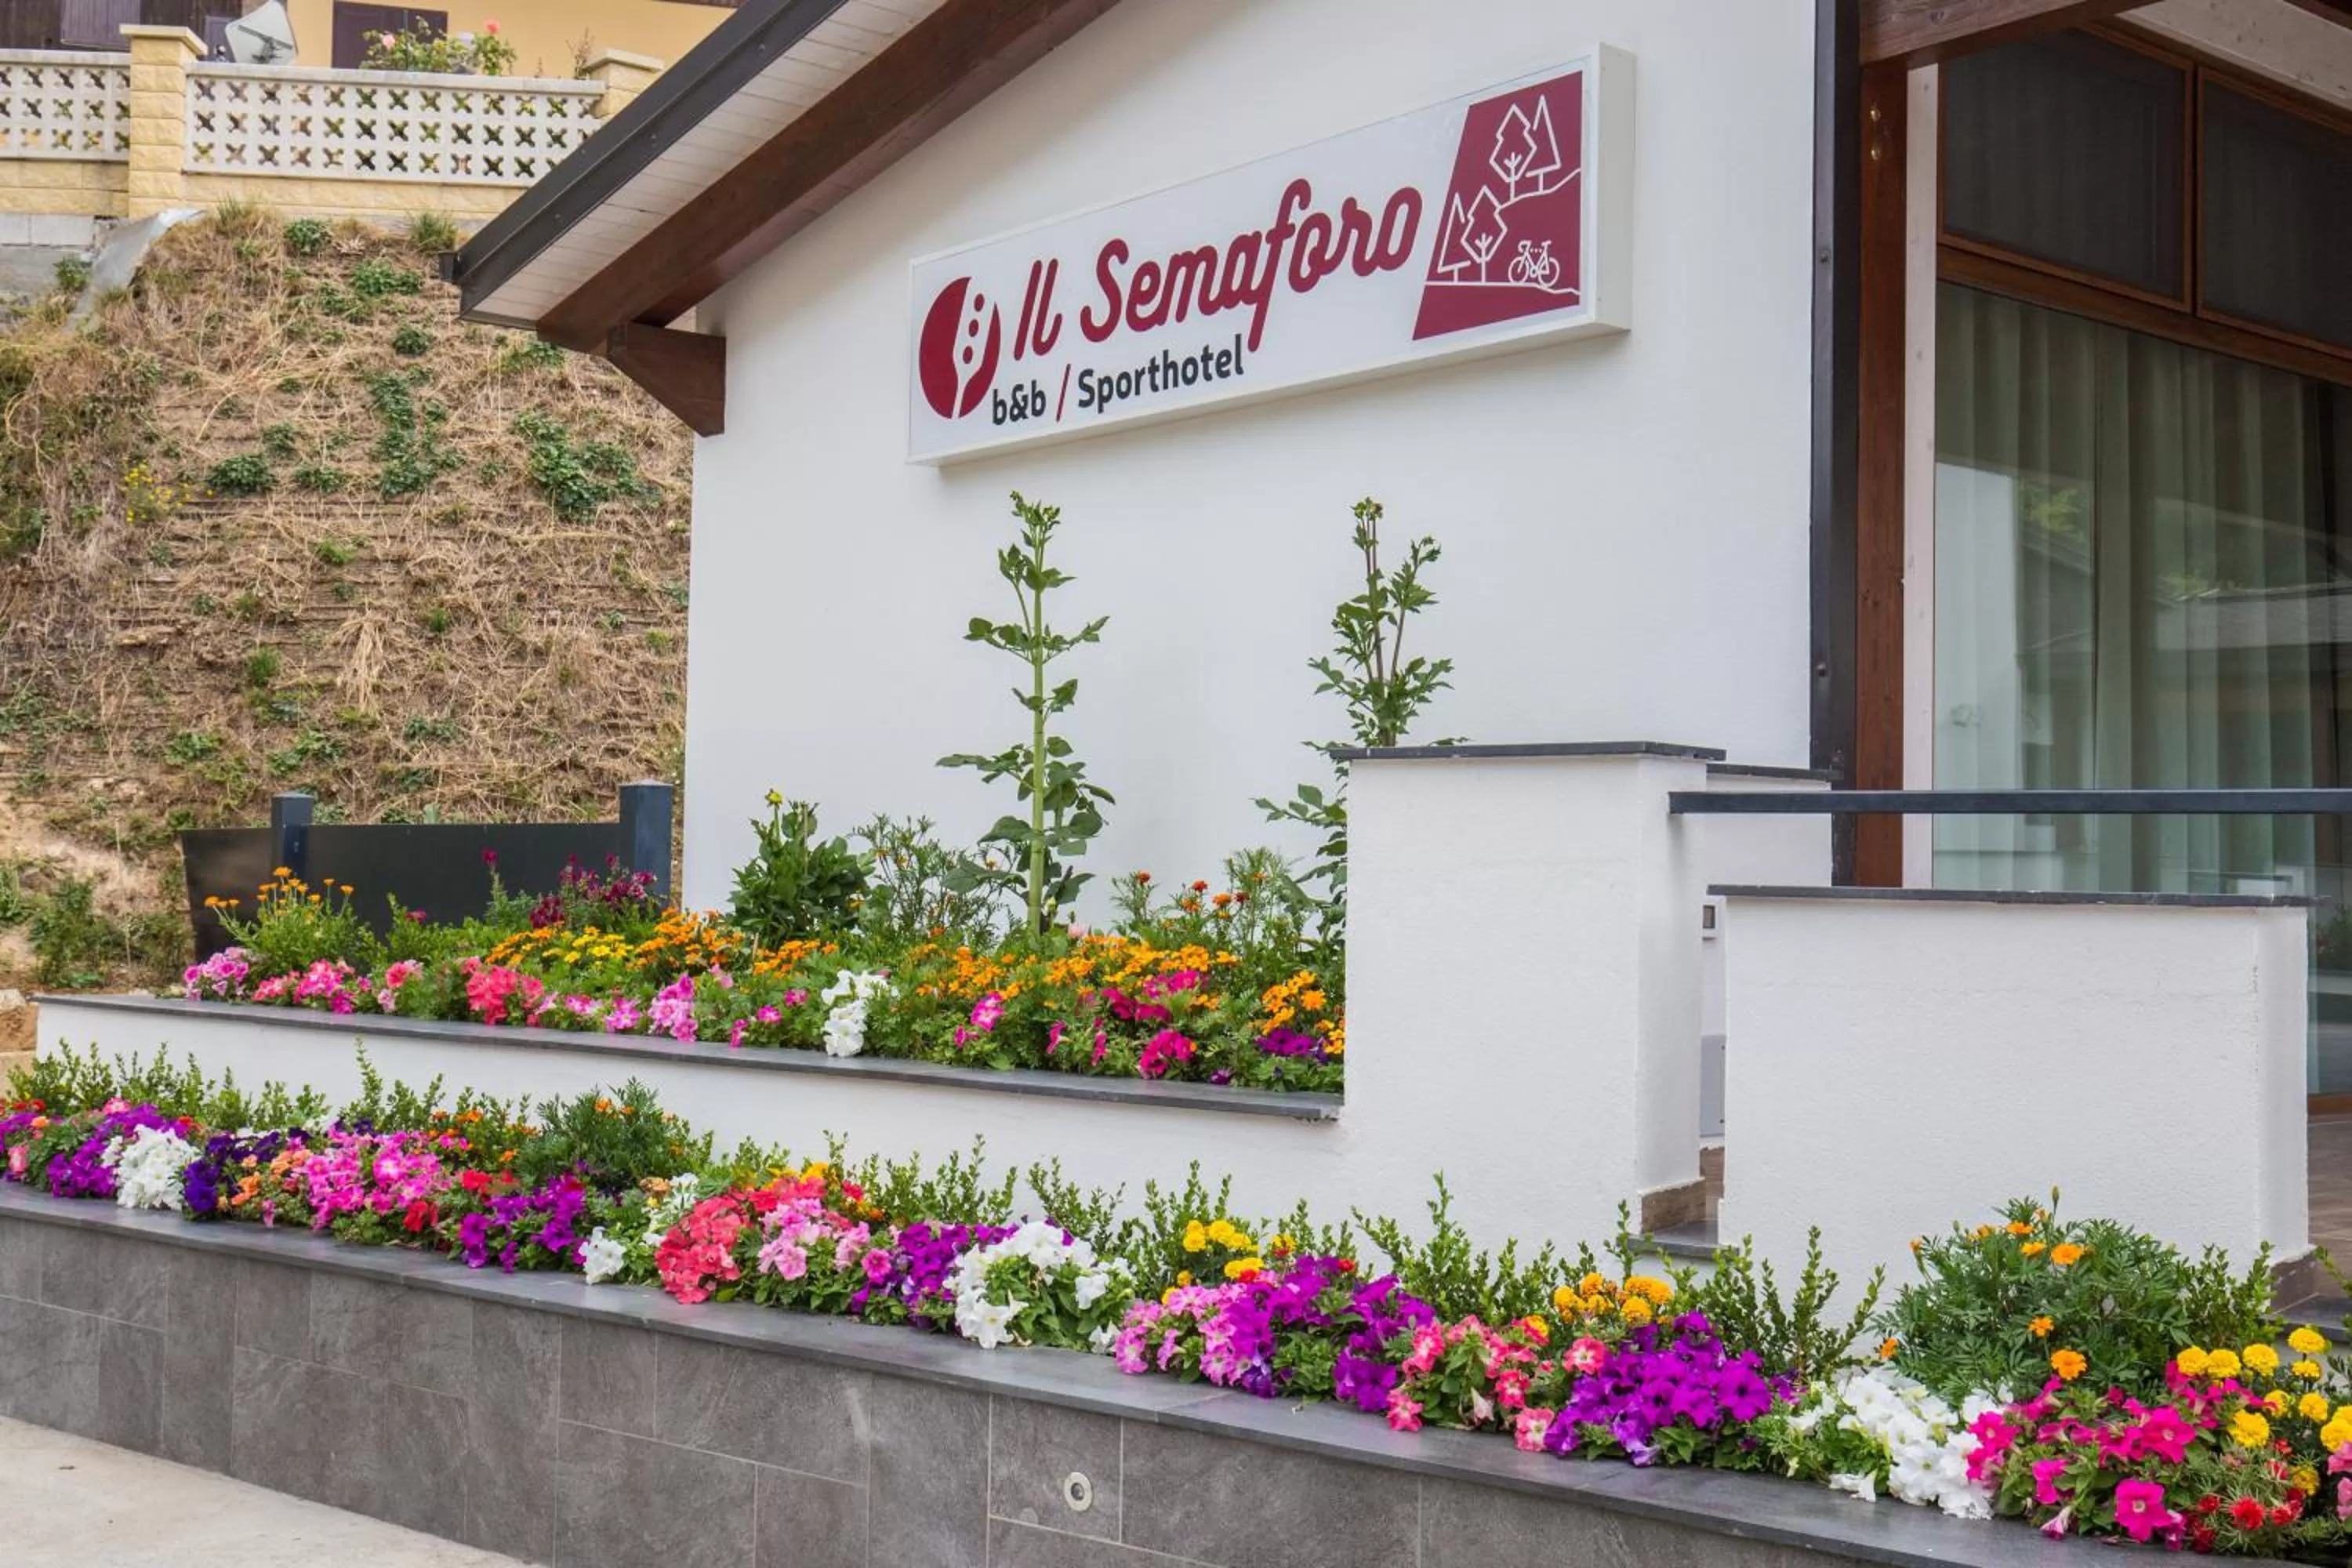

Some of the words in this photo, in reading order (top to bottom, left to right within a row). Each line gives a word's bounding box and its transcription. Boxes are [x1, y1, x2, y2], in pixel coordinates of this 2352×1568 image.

[1013, 258, 1063, 361] Il
[1080, 178, 1423, 353] Semaforo
[992, 380, 1047, 426] b&b
[1078, 333, 1244, 413] Sporthotel
